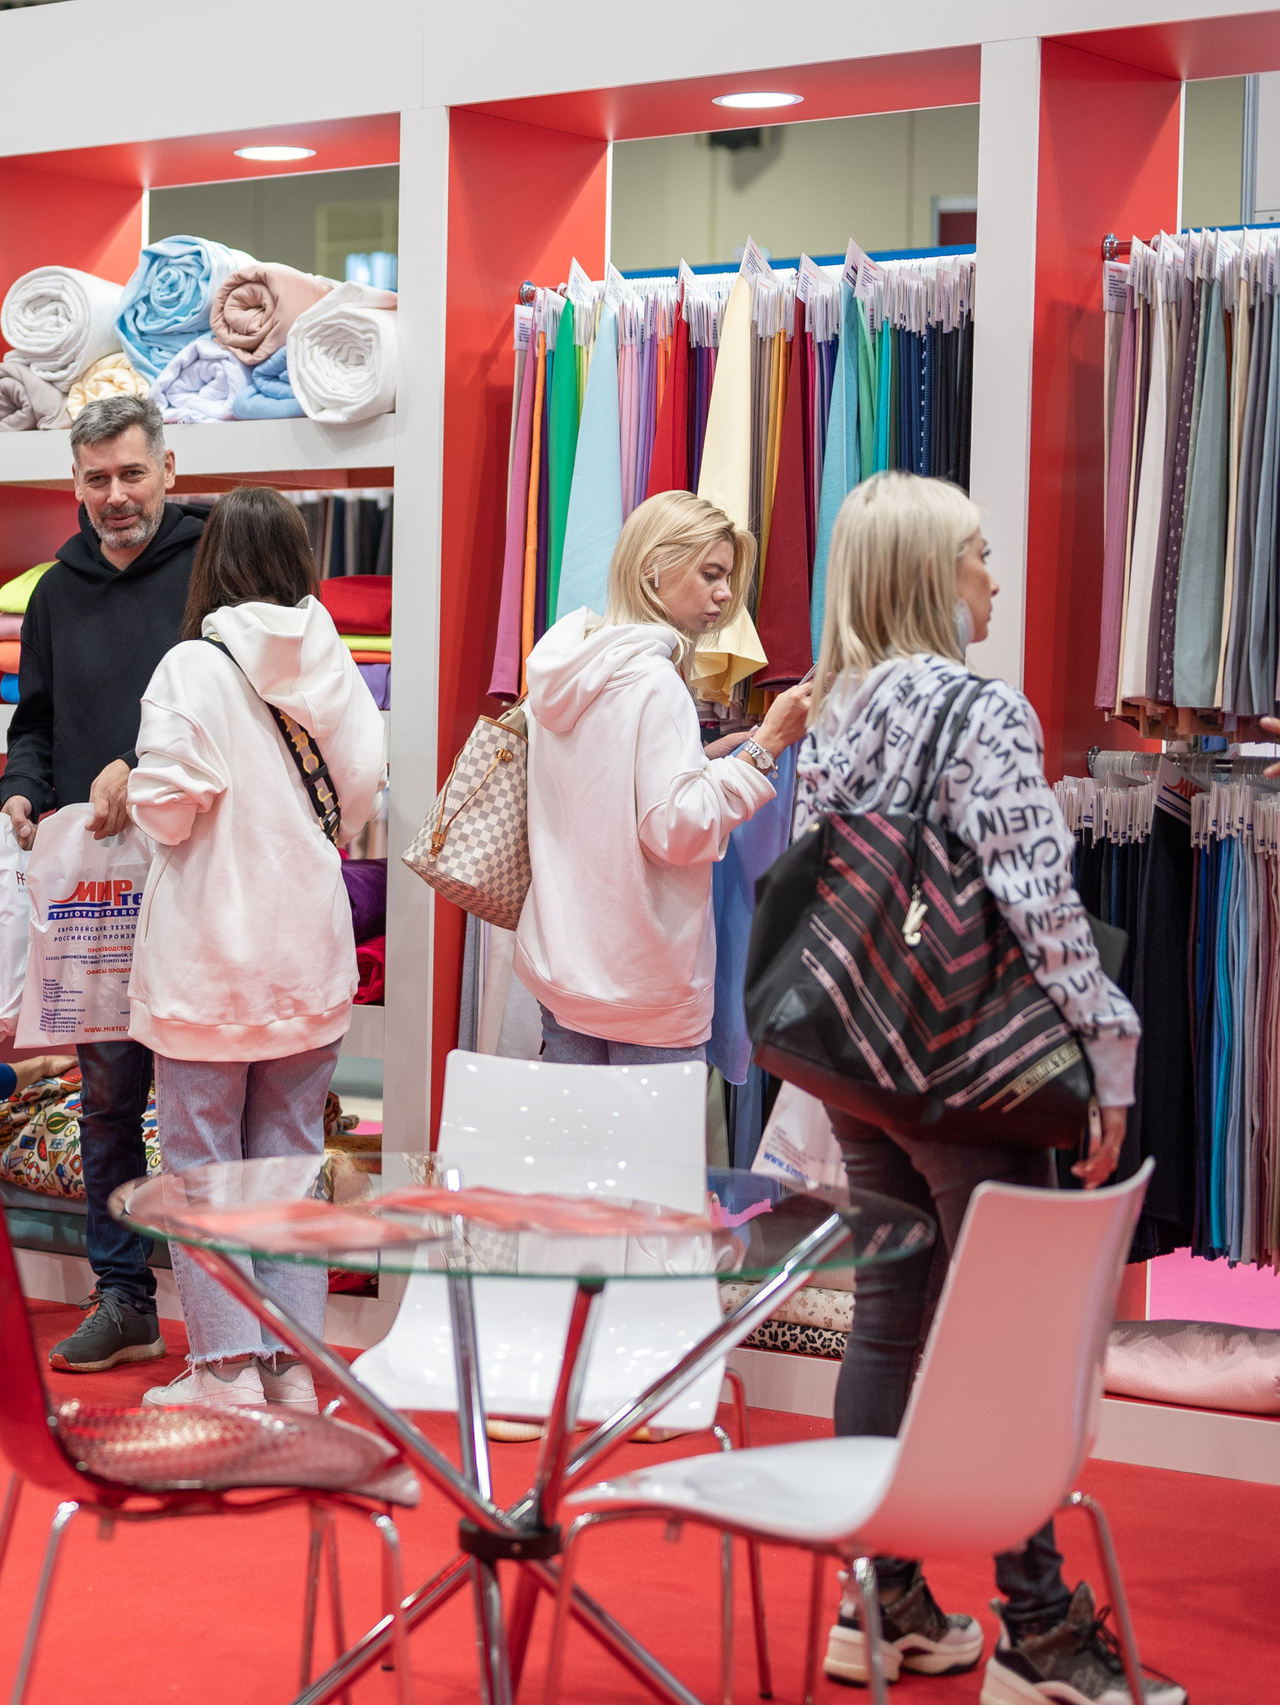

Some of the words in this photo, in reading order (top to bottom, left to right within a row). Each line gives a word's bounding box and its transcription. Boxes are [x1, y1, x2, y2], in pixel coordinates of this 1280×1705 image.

[277, 708, 320, 775] ARC
[53, 910, 119, 919] ТРИКОТАЖНОЕ
[57, 924, 107, 933] ЕВРОПЕЙСКИЕ
[87, 945, 132, 953] ПРОИЗВОДСТВО
[83, 1025, 129, 1033] WWW.MIRTEX.
